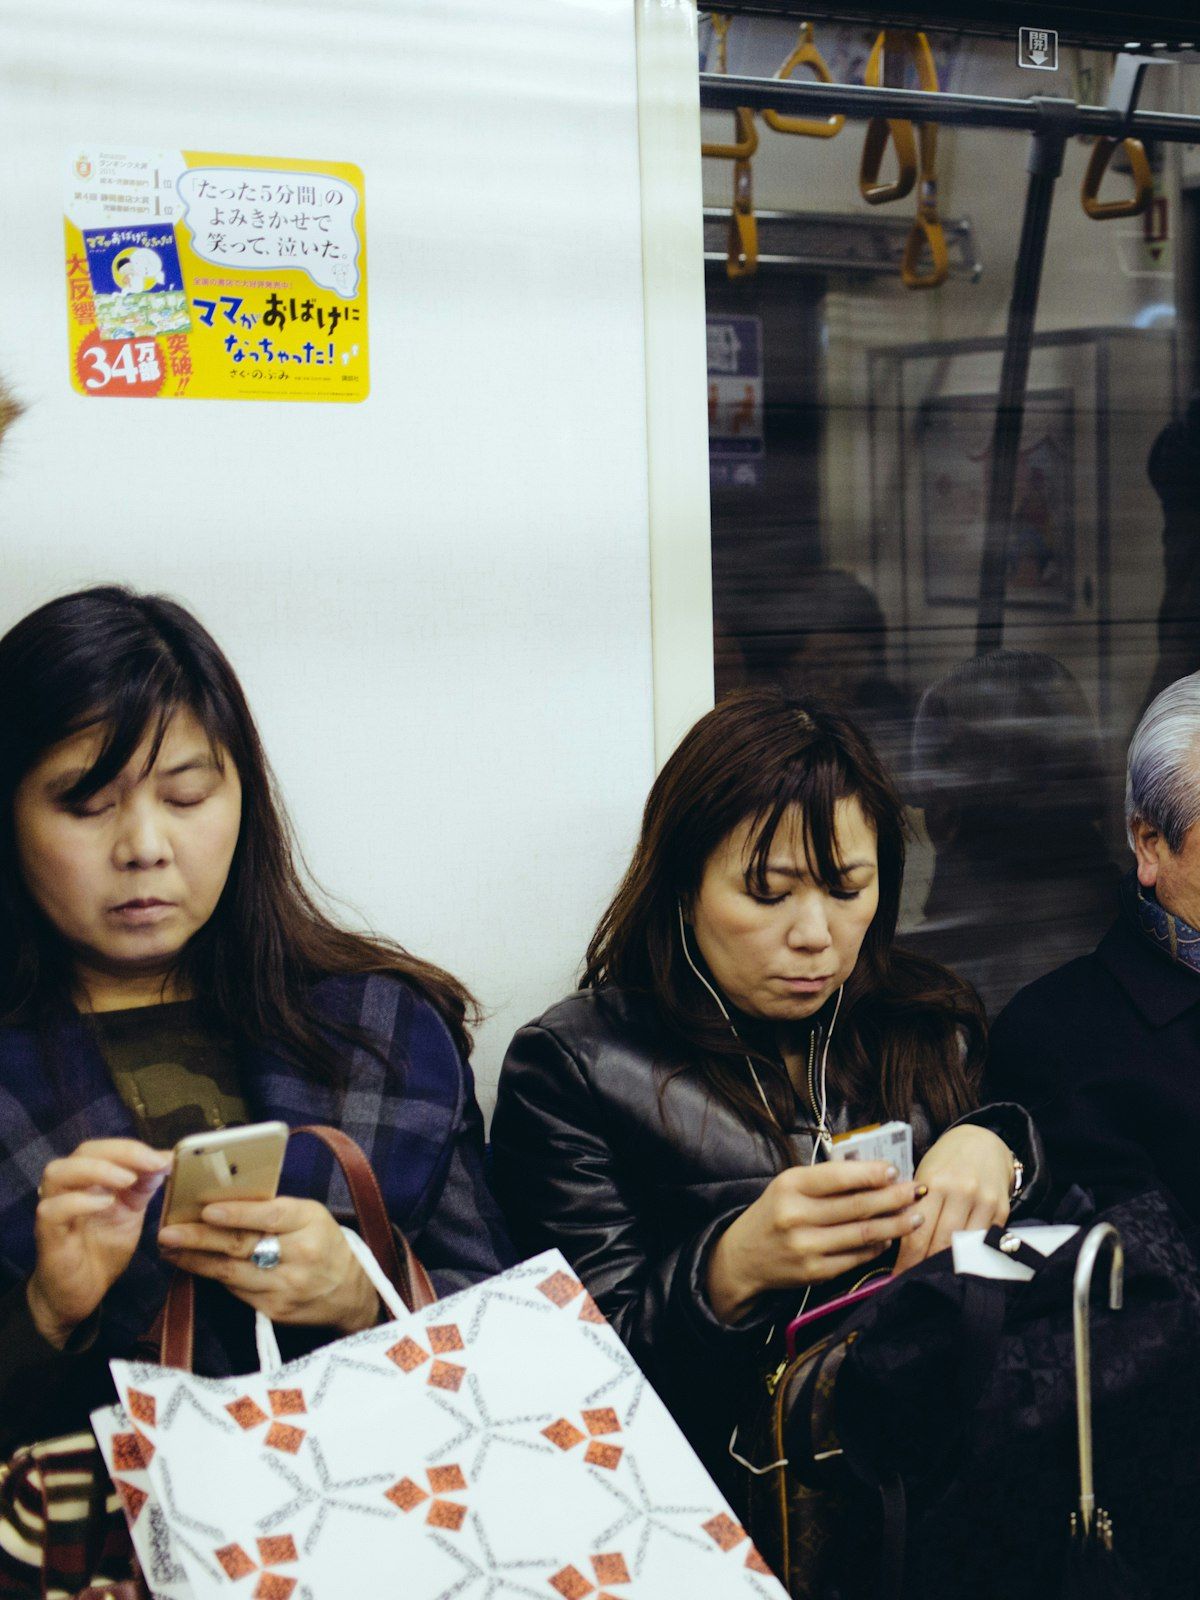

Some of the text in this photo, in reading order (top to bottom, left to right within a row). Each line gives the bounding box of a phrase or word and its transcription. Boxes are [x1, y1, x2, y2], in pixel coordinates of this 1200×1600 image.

[1029, 31, 1048, 51] 開
[209, 207, 332, 232] よみきかせで
[207, 232, 349, 260] 笑って、泣いた。
[193, 293, 361, 336] ママがおばけに
[224, 334, 335, 364] なっちゃった!
